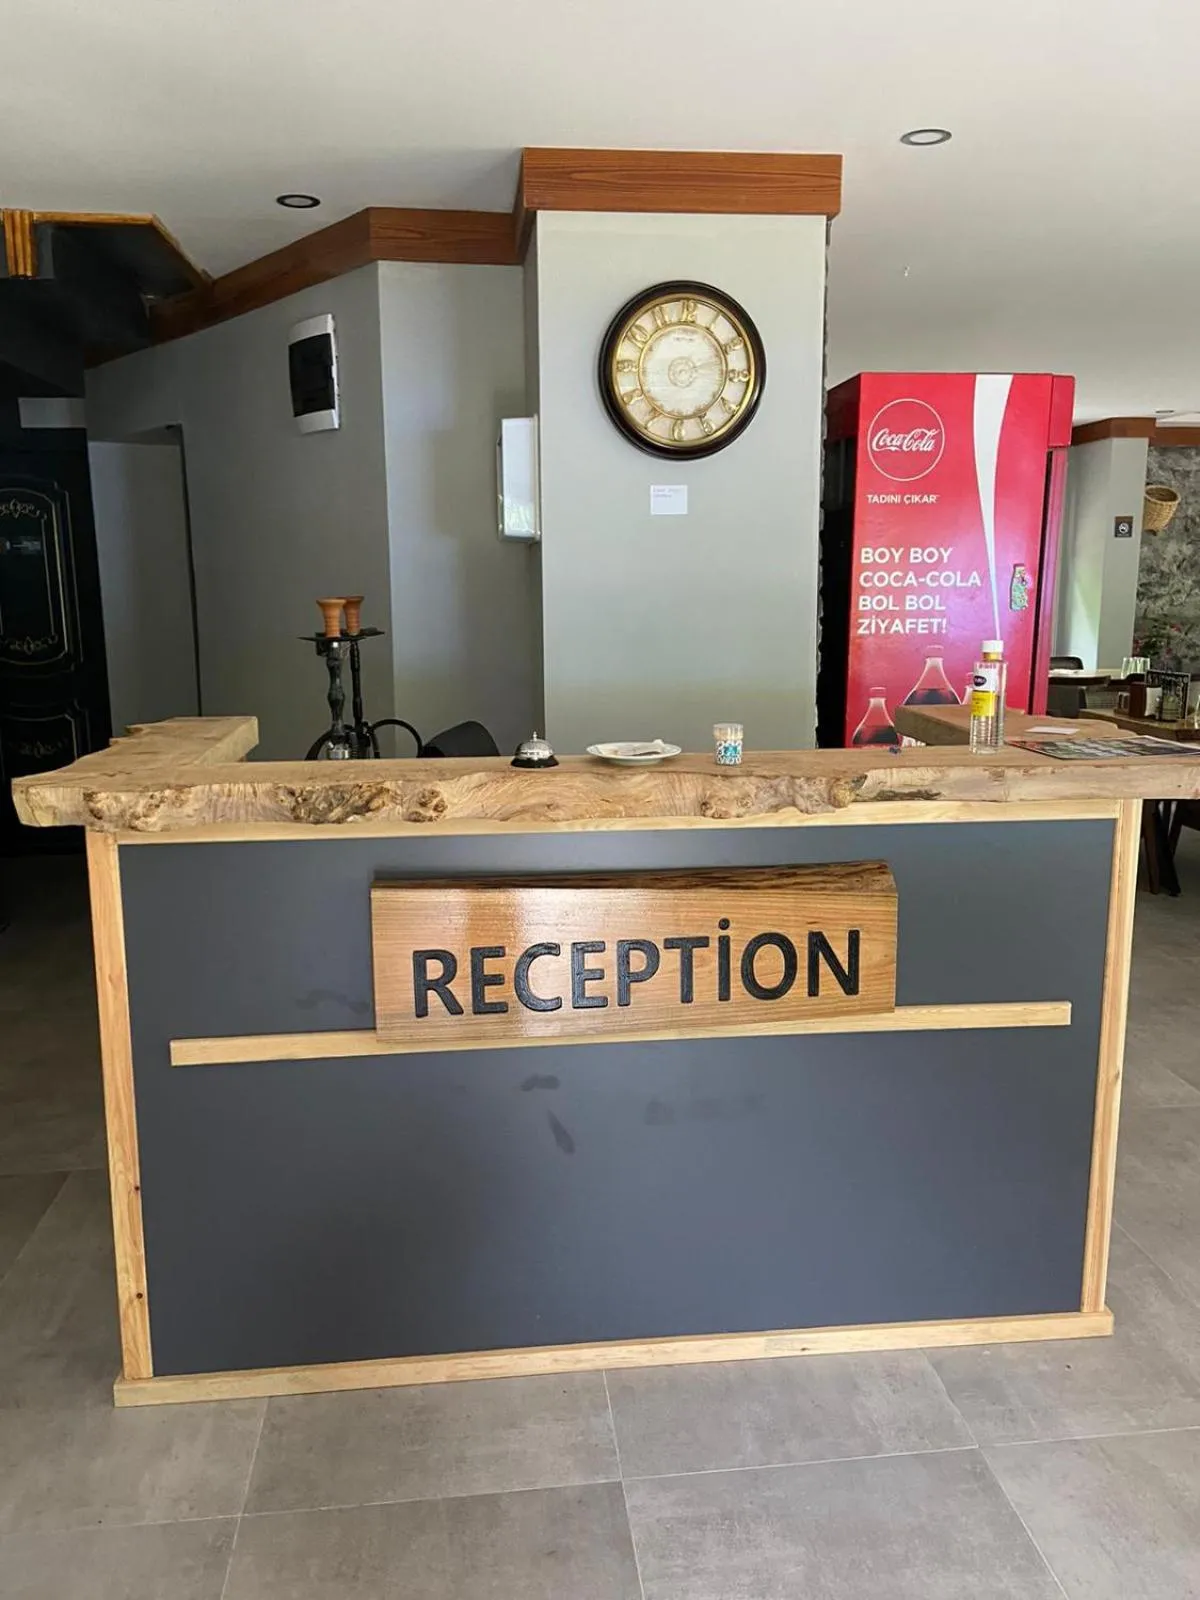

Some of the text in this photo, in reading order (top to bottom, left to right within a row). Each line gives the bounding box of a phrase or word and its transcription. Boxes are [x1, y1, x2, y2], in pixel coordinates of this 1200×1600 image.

[867, 494, 901, 504] TADINI
[860, 547, 953, 563] BOY BOY
[859, 571, 981, 587] COCA-COLA
[858, 595, 946, 611] BOL BOL
[857, 615, 947, 634] ZİYAFET!
